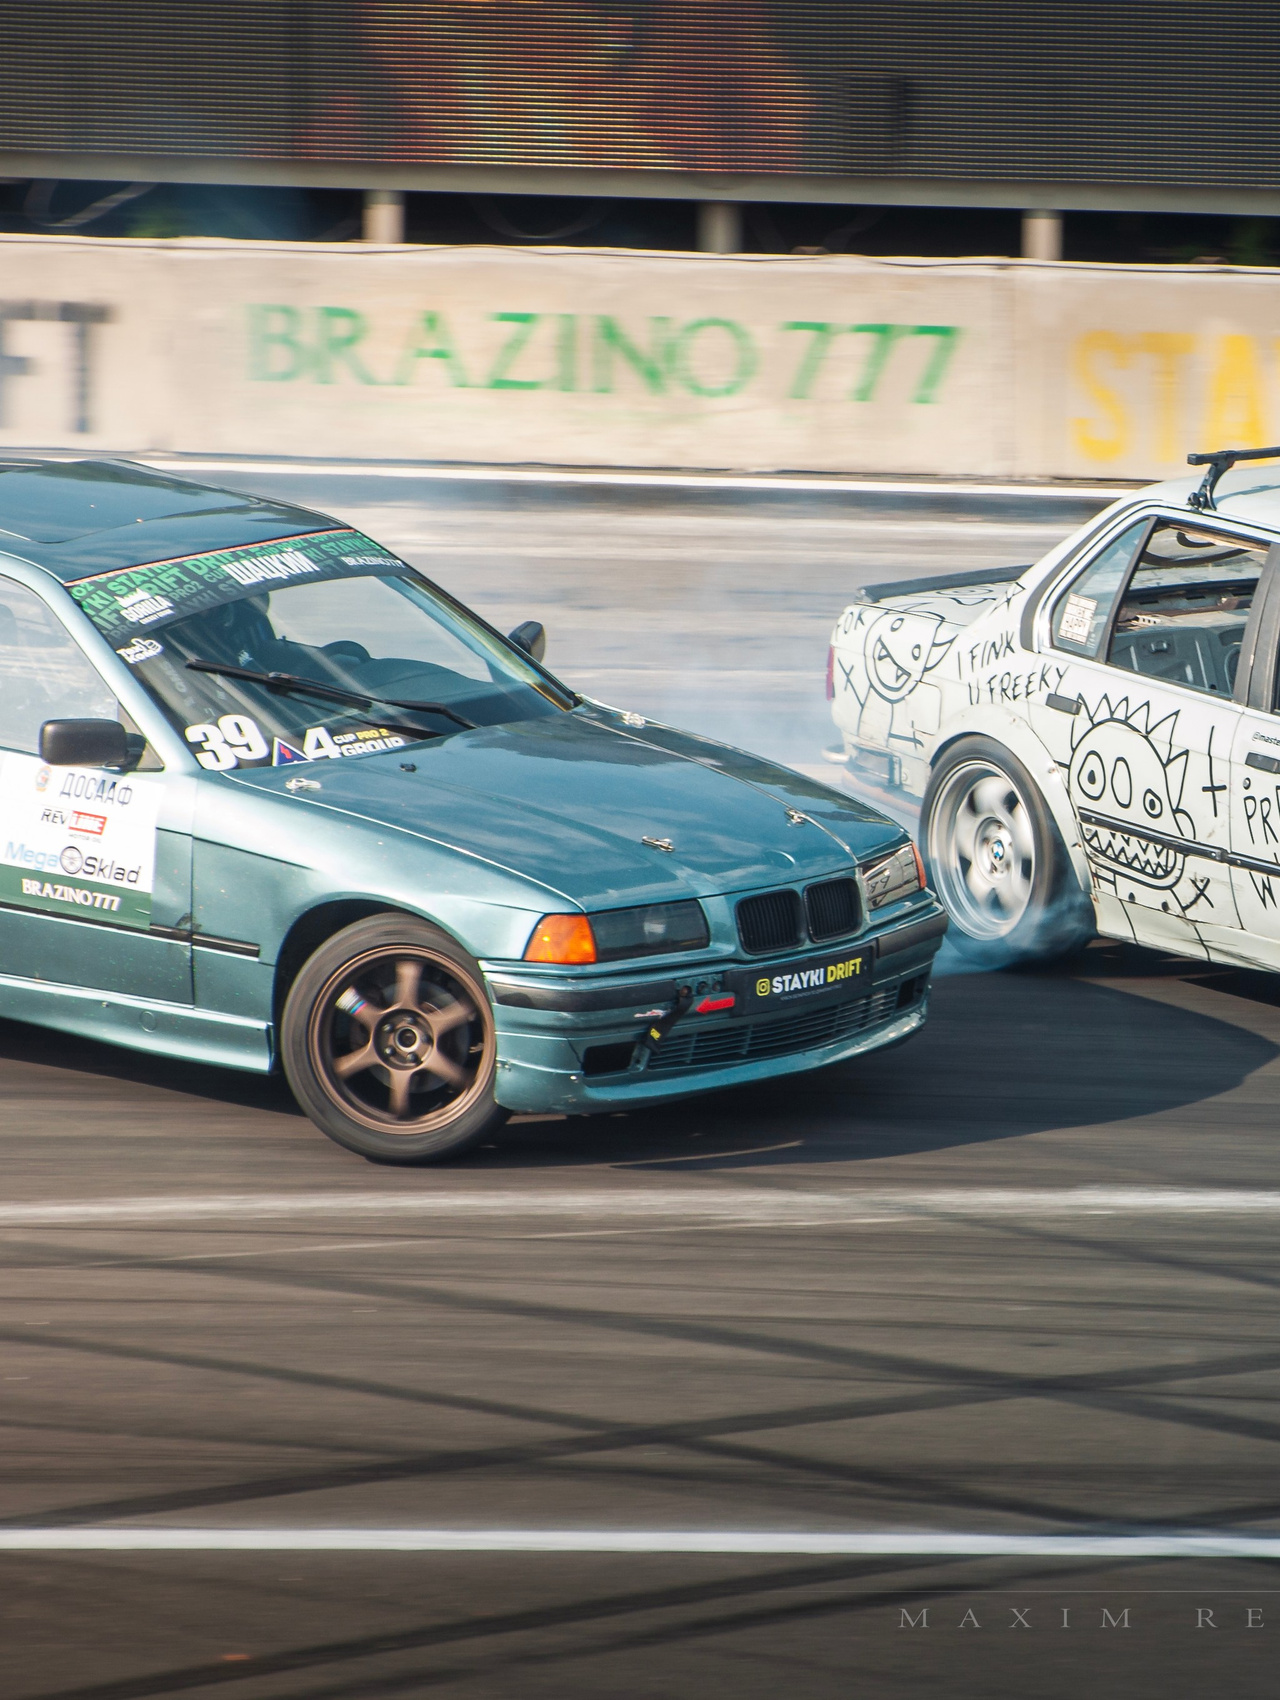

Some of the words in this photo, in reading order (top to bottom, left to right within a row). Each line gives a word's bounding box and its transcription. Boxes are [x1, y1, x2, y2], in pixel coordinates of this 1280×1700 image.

[245, 303, 759, 398] BRAZINO
[782, 320, 959, 405] 777
[220, 547, 320, 586] ШАЦКИЙ
[120, 595, 174, 623] GORILLA
[968, 631, 1015, 672] FINK
[185, 714, 269, 771] 39
[303, 726, 342, 759] 4
[333, 733, 357, 744] CUP
[355, 730, 379, 741] PRO
[60, 772, 133, 806] ДОСААФ
[772, 967, 825, 994] STAYKI
[827, 957, 862, 983] DRIFT
